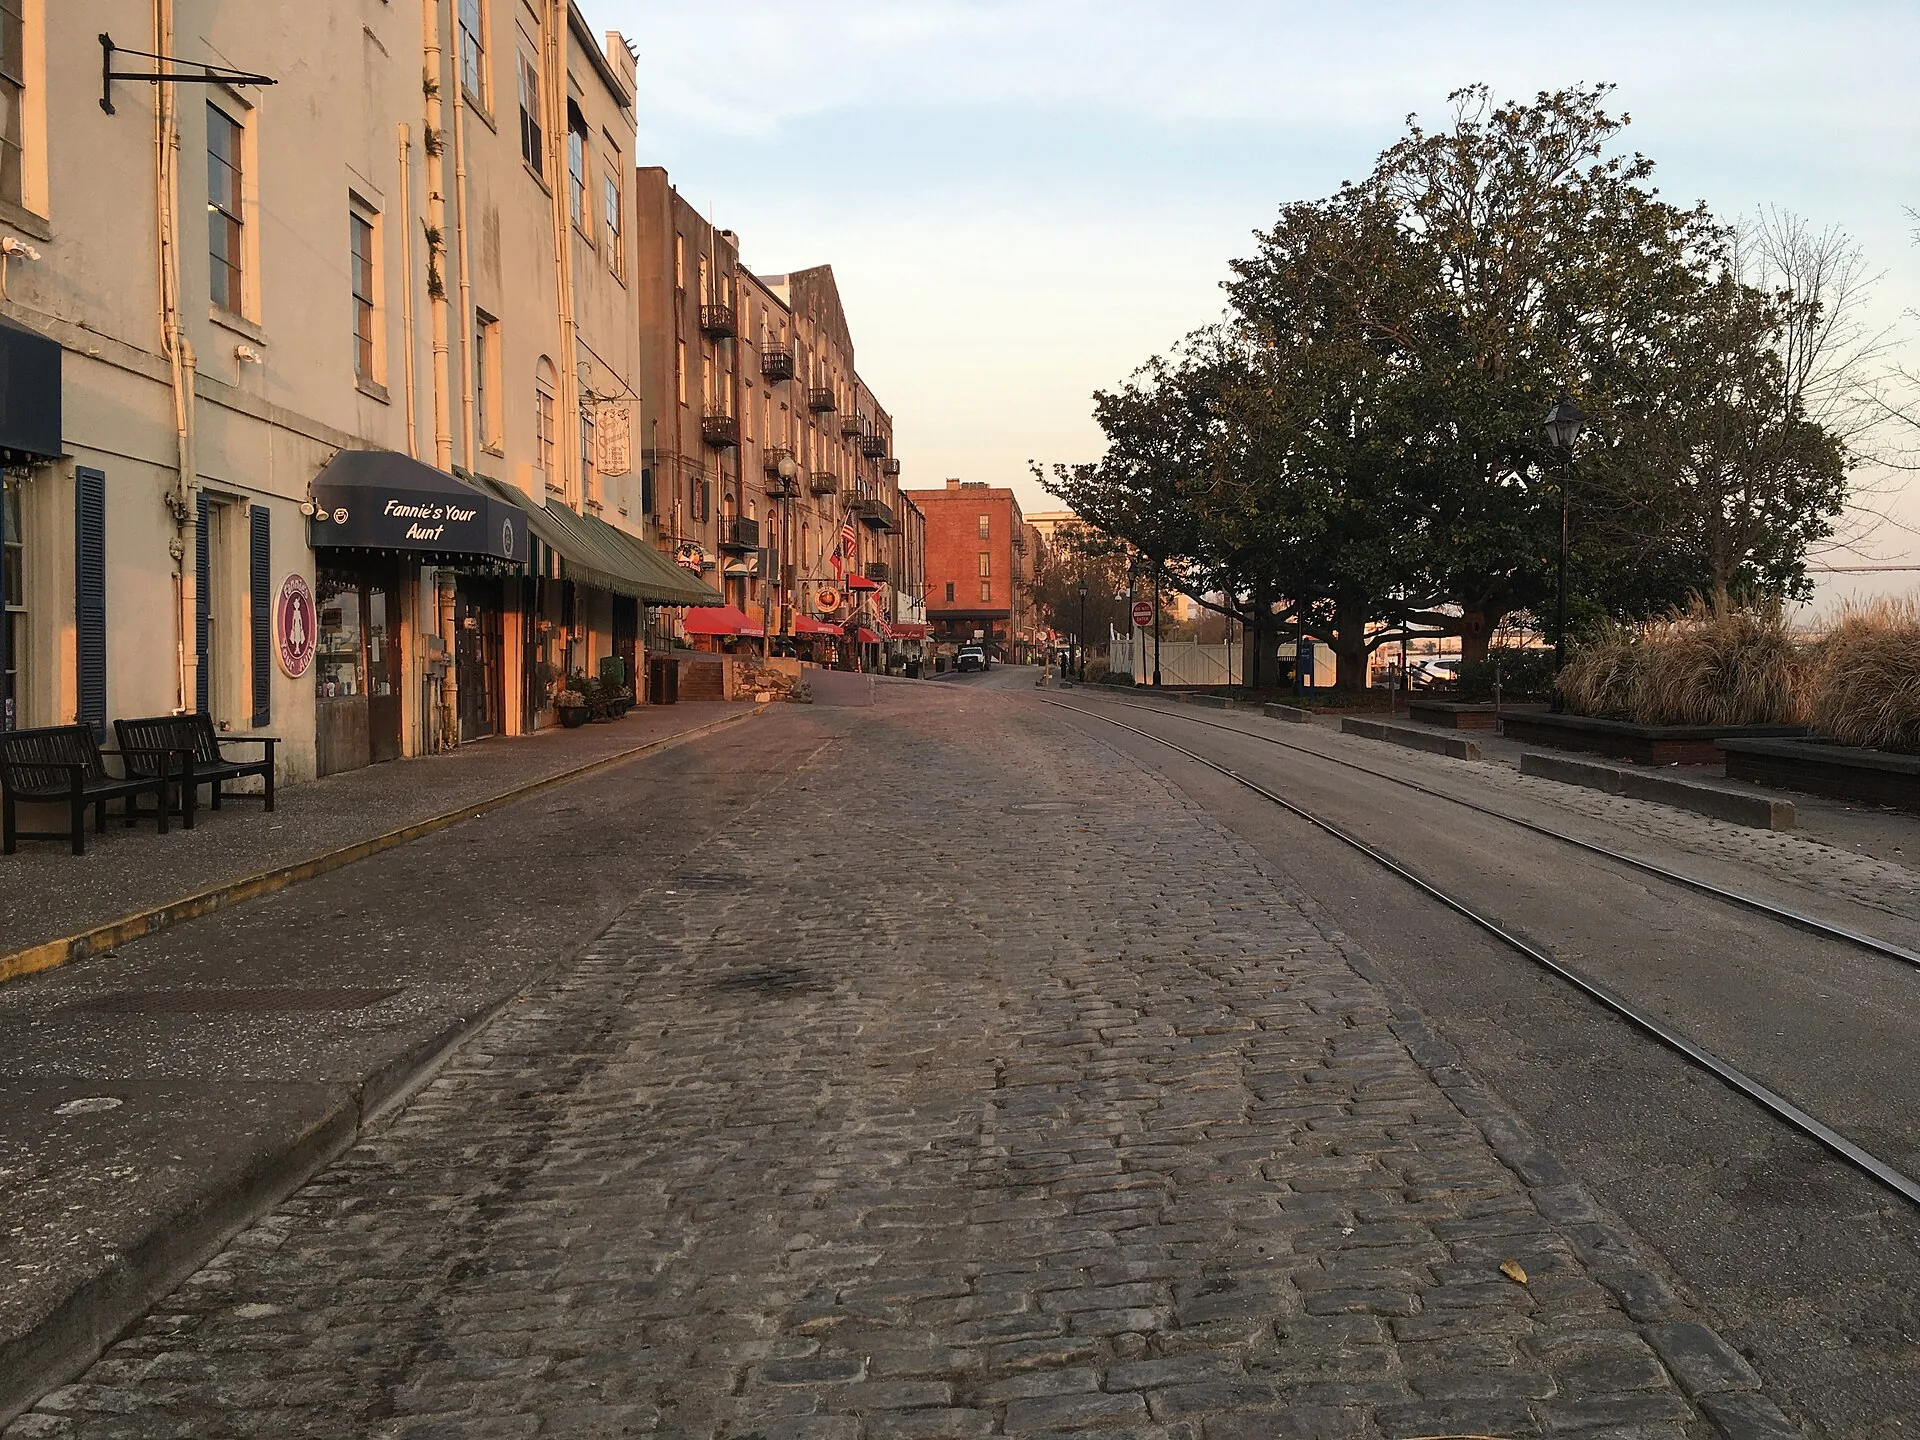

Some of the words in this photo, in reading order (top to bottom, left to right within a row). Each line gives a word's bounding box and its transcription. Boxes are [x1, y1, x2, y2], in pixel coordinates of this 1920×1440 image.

[383, 499, 443, 520] Fannie's
[445, 504, 476, 521] Your
[405, 522, 444, 541] Aunt
